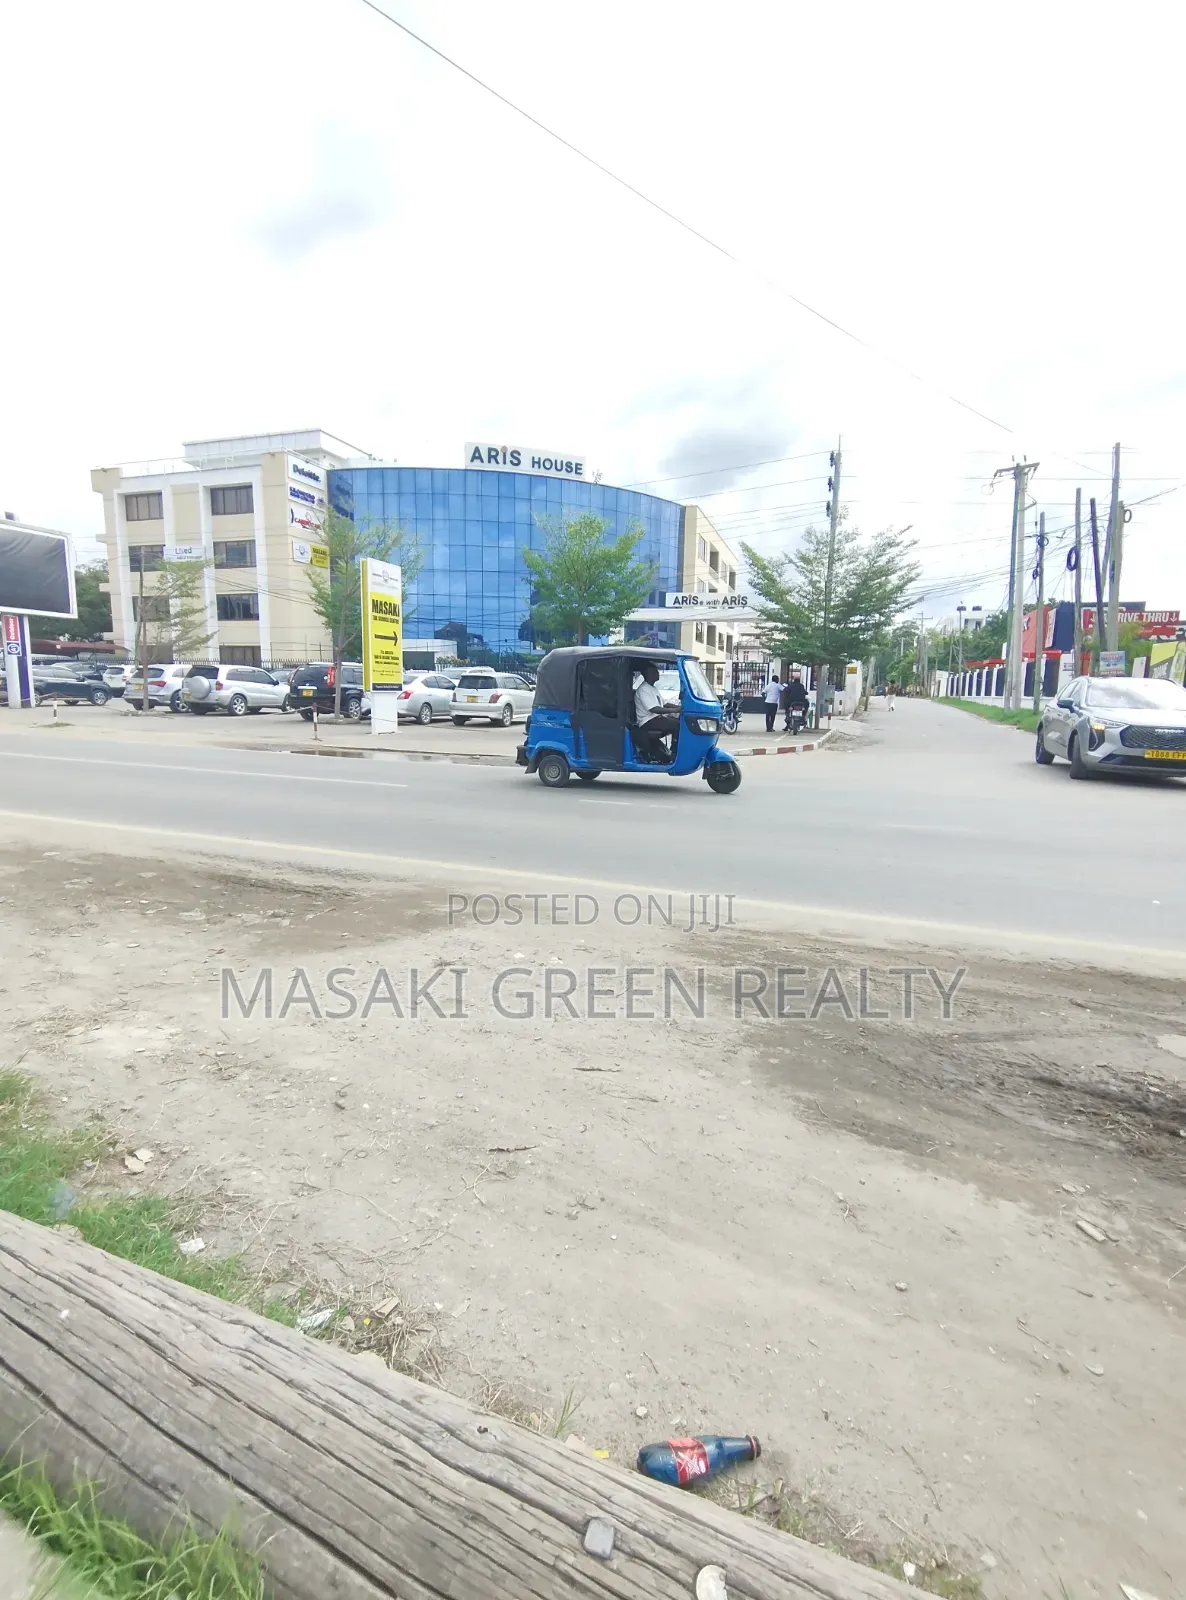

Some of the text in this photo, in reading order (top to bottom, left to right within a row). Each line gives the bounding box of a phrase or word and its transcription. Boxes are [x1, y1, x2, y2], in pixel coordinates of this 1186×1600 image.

[531, 456, 584, 476] HOUSE
[371, 598, 400, 618] MASAKI
[1117, 612, 1170, 623] RIVE THRU
